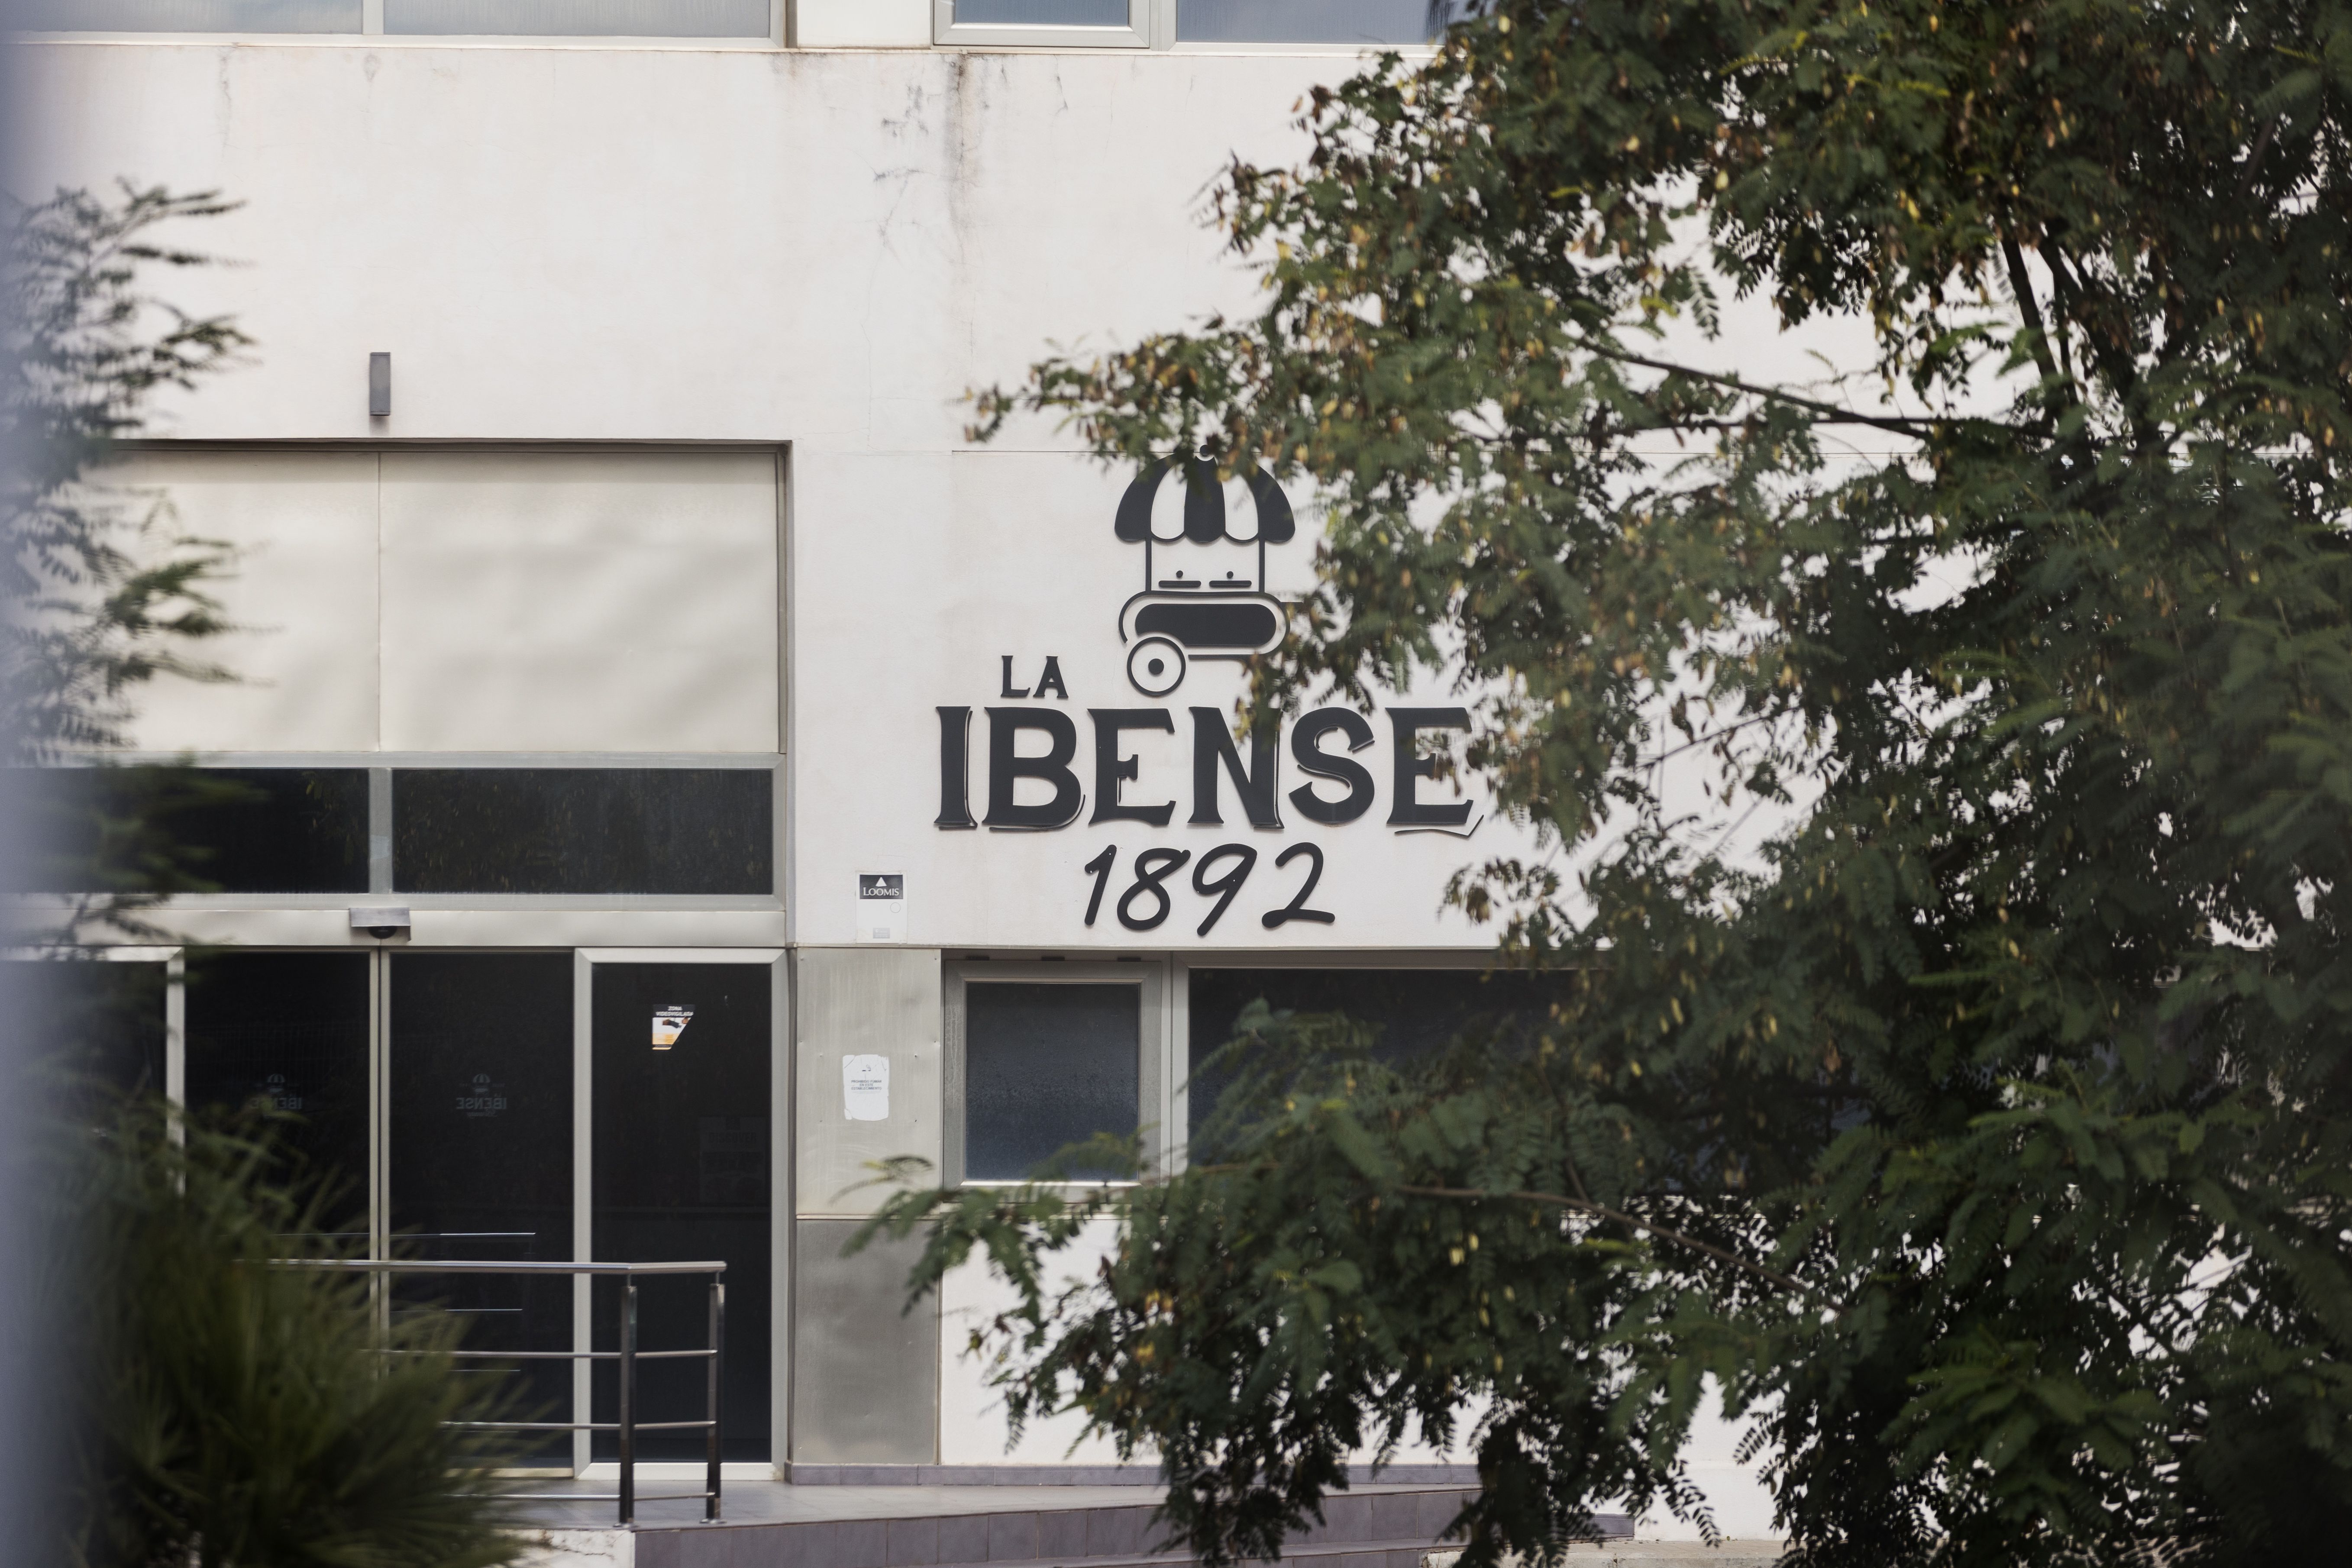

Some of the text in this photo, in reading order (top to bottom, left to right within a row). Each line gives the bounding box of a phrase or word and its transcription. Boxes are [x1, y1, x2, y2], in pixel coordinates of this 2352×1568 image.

[1000, 655, 1069, 699] LA
[934, 706, 1484, 838] IBENSE
[863, 887, 899, 896] LOOMIS
[1083, 842, 1336, 937] 1892
